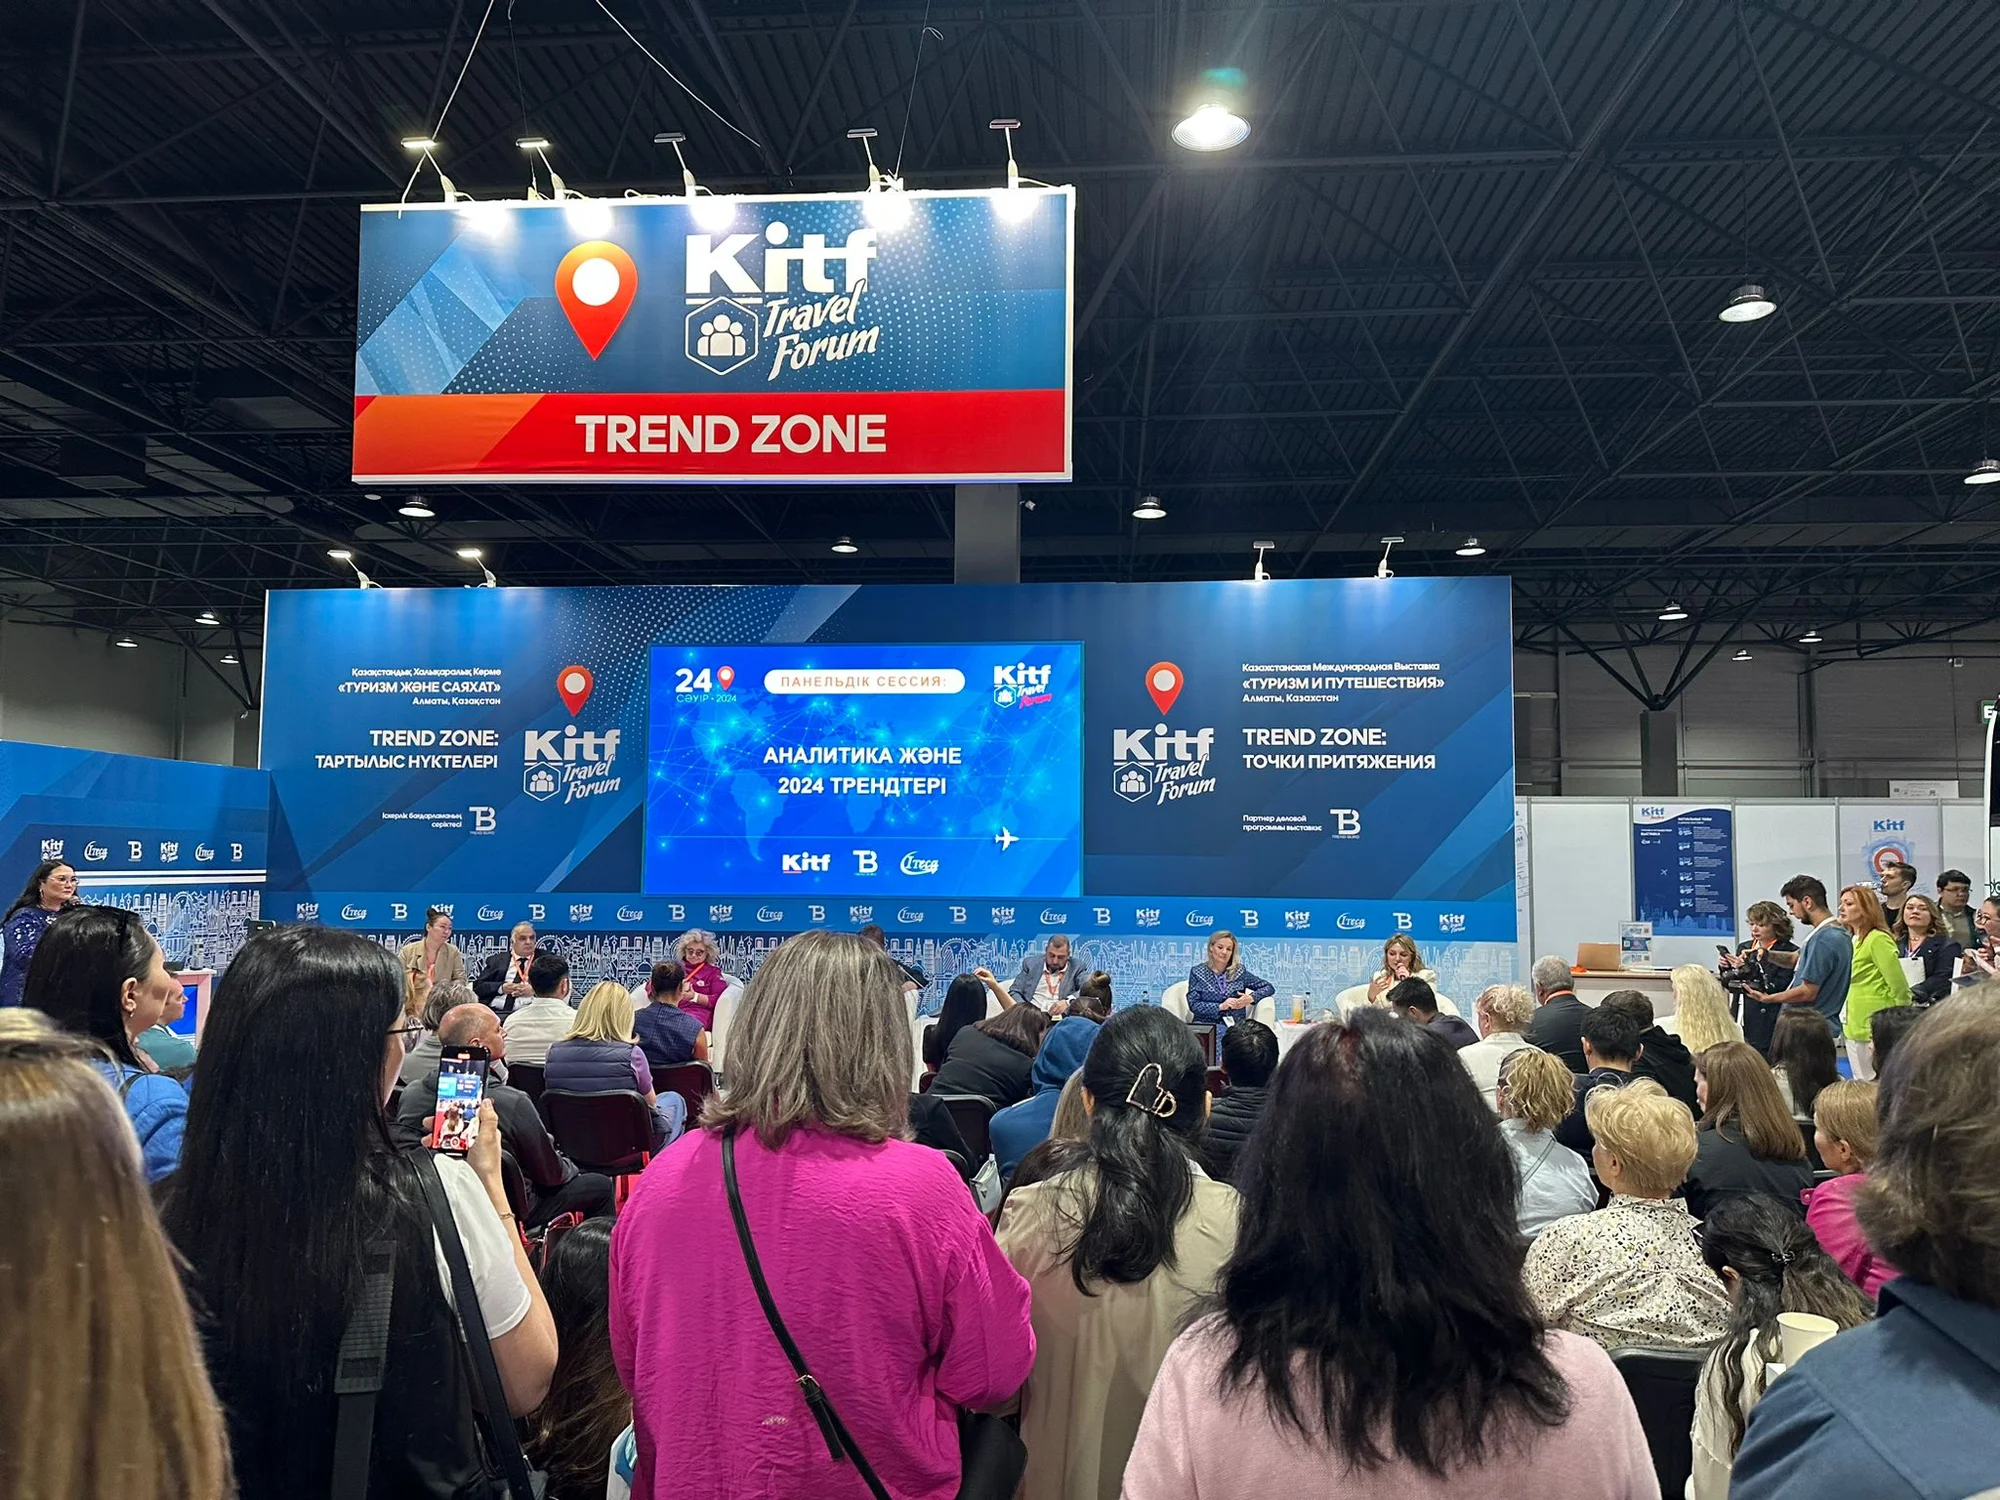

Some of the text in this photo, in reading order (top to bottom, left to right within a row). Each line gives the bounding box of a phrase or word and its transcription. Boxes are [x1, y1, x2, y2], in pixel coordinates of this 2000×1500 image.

[686, 221, 877, 293] Kitf
[762, 278, 866, 338] Travel
[767, 326, 880, 381] Forum
[575, 414, 887, 453] TREND ZONE
[993, 662, 1052, 685] Kitf
[1242, 662, 1440, 673] Казахстанская Международная Выставка
[338, 681, 501, 693] «ТУРИЗМ ЖӘНЕ САЯХАТ»
[675, 668, 712, 693] 24
[781, 676, 947, 688] ПАНЕЛЬДІК СЕССИЯ:
[1242, 676, 1445, 690] «ТУРИЗМ И ПУТЕШЕСТВИЯ»
[412, 697, 501, 706] Алматы, Қазақстан
[676, 694, 737, 703] СӘУІР 2024
[1242, 694, 1339, 703] Алматы, Казахстан
[370, 730, 499, 746] TREND ZONE:
[524, 725, 621, 761] Kitf
[1113, 723, 1214, 761] Kitf
[1242, 728, 1387, 745] TREND ZONE:
[315, 755, 498, 769] ТАРТЫЛЫС НҮКТЕЛЕРІ
[763, 747, 962, 764] АНАЛИТИКА ЖӘНЕ
[1242, 754, 1436, 769] ТОЧКИ ПРИТЯЖЕНИЯ
[562, 754, 614, 783] Travel
[1154, 753, 1208, 783] Travel
[564, 777, 621, 805] Forum
[777, 777, 947, 797] 2024 ТРЕНДТЕРІ
[1156, 777, 1216, 805] Forum
[1243, 815, 1307, 823] Партнер деловой
[1873, 819, 1905, 831] Kitf
[41, 839, 64, 850] Kitf
[160, 841, 179, 852] Kitf
[782, 851, 831, 872] Kitf
[297, 903, 319, 912] Kitf
[570, 904, 593, 913] Kitf
[710, 904, 732, 914] Kitf
[850, 905, 873, 915] Kitf
[992, 907, 1015, 916] Kitf
[1136, 908, 1160, 918] Kitf
[1285, 910, 1310, 921] Kitf
[1440, 913, 1465, 924] Kitf
